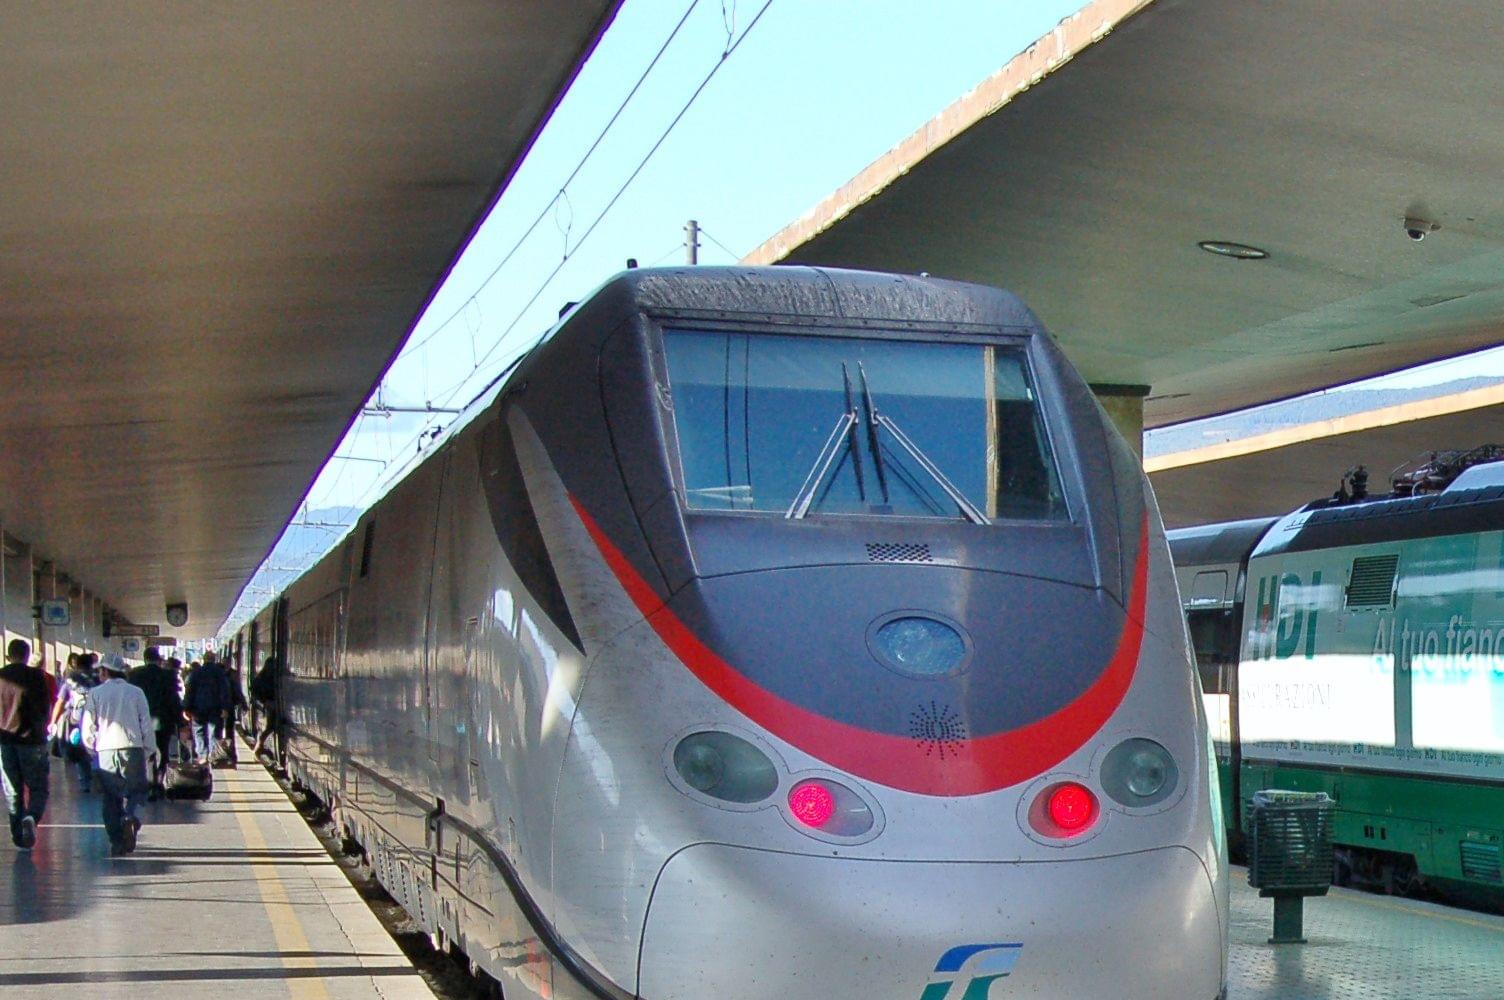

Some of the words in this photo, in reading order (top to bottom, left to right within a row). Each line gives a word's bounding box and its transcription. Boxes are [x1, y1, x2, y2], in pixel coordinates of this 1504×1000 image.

[1252, 571, 1322, 661] HDI
[1373, 617, 1396, 668] Al
[1401, 619, 1439, 671] tuo
